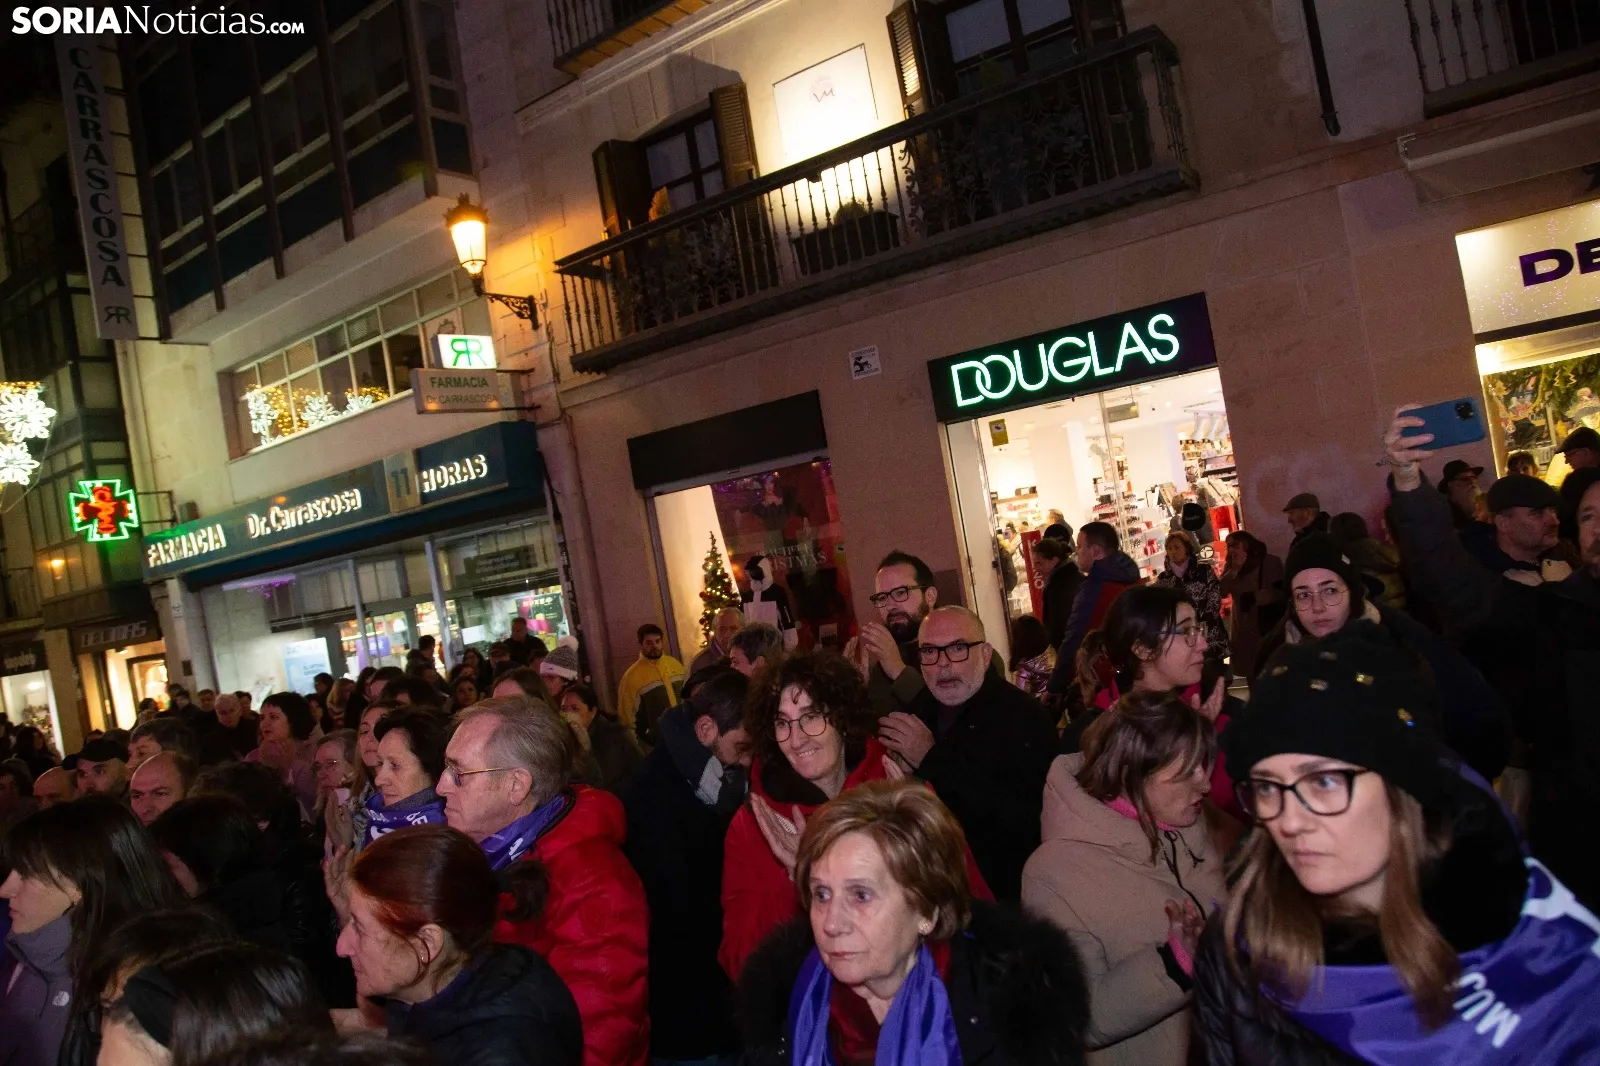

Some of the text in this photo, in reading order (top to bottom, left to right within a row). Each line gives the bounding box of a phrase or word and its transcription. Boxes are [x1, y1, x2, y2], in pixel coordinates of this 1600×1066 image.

[68, 47, 125, 287] CARRASCOSA
[429, 376, 490, 389] FARMACIA
[950, 313, 1180, 408] DOUGLAS
[147, 523, 227, 568] FARMACIA
[246, 513, 271, 539] Dr.
[269, 488, 363, 533] Carrascosa
[421, 454, 488, 493] HORAS
[771, 551, 827, 570] ISTMAS
[1448, 972, 1521, 1048] MUJ
